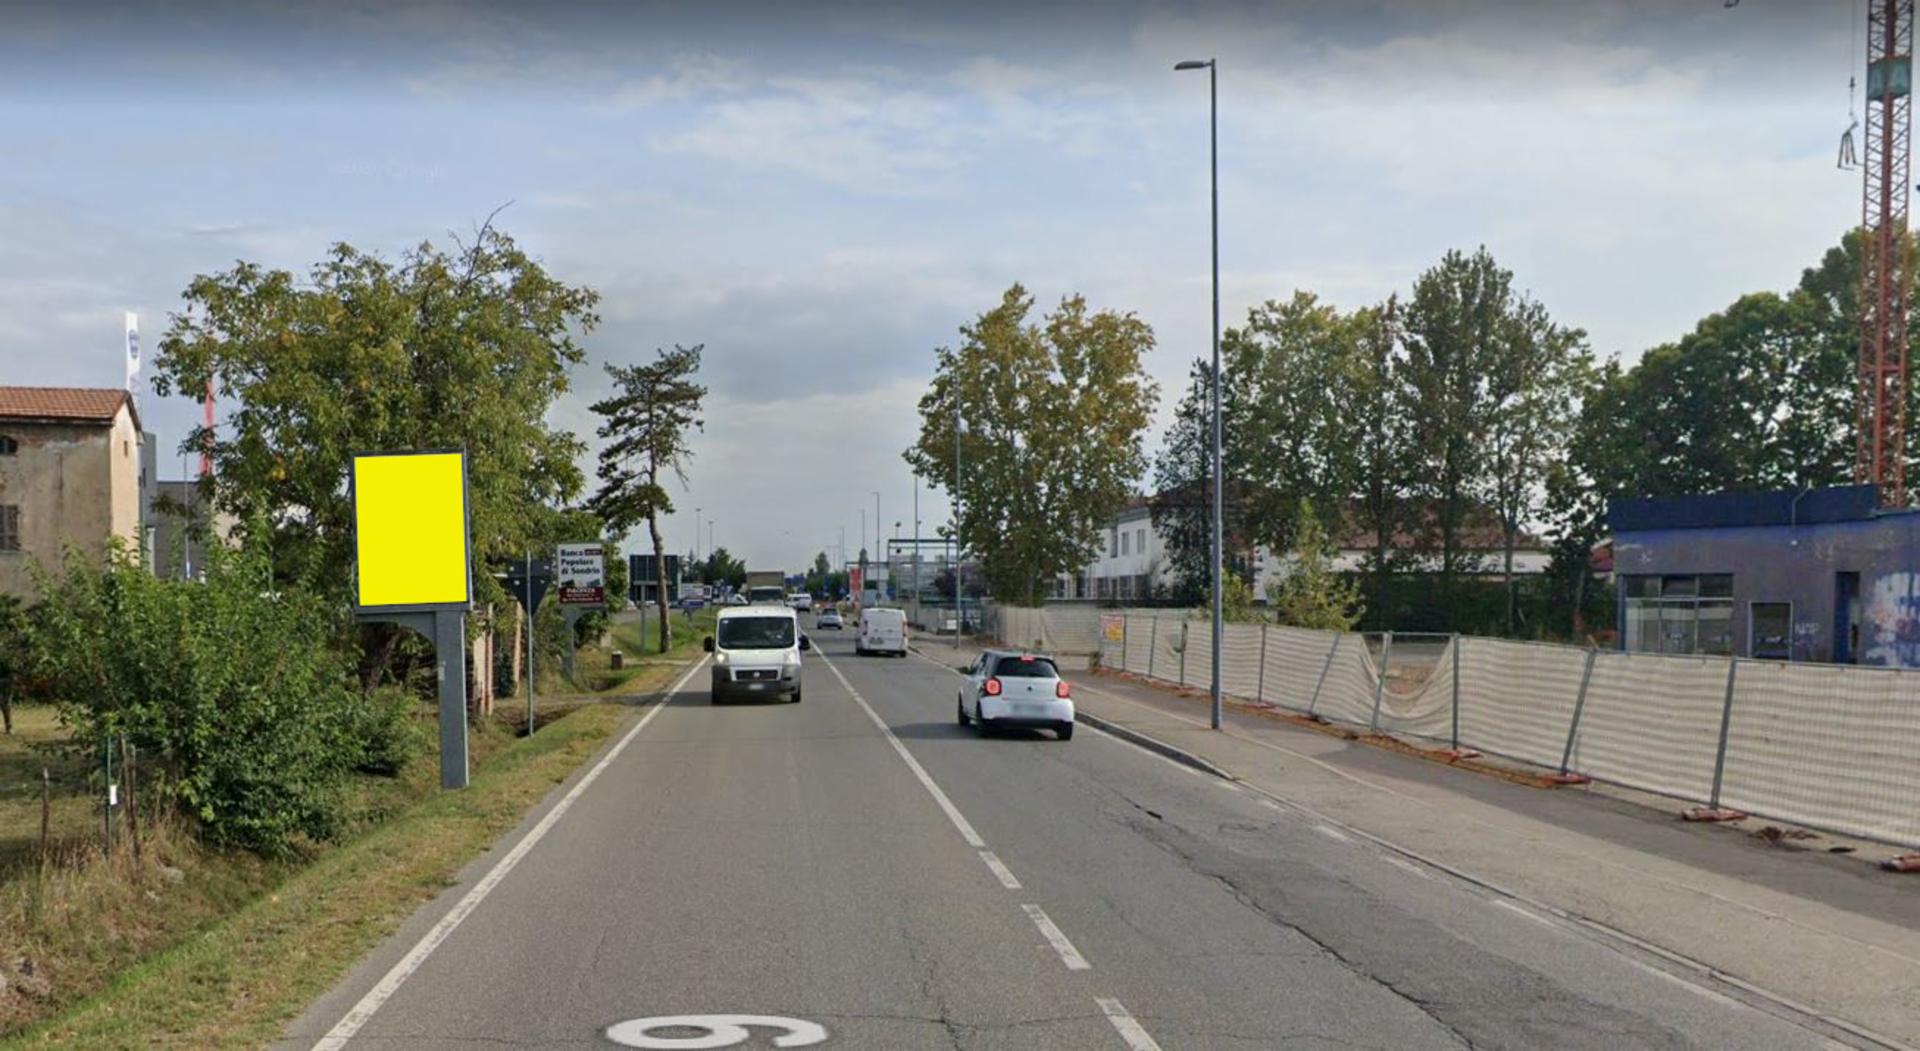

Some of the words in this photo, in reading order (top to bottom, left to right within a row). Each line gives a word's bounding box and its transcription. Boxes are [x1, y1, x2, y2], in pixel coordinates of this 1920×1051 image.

[561, 558, 594, 566] Popolare
[562, 567, 568, 575] di
[571, 567, 600, 575] Sondrio
